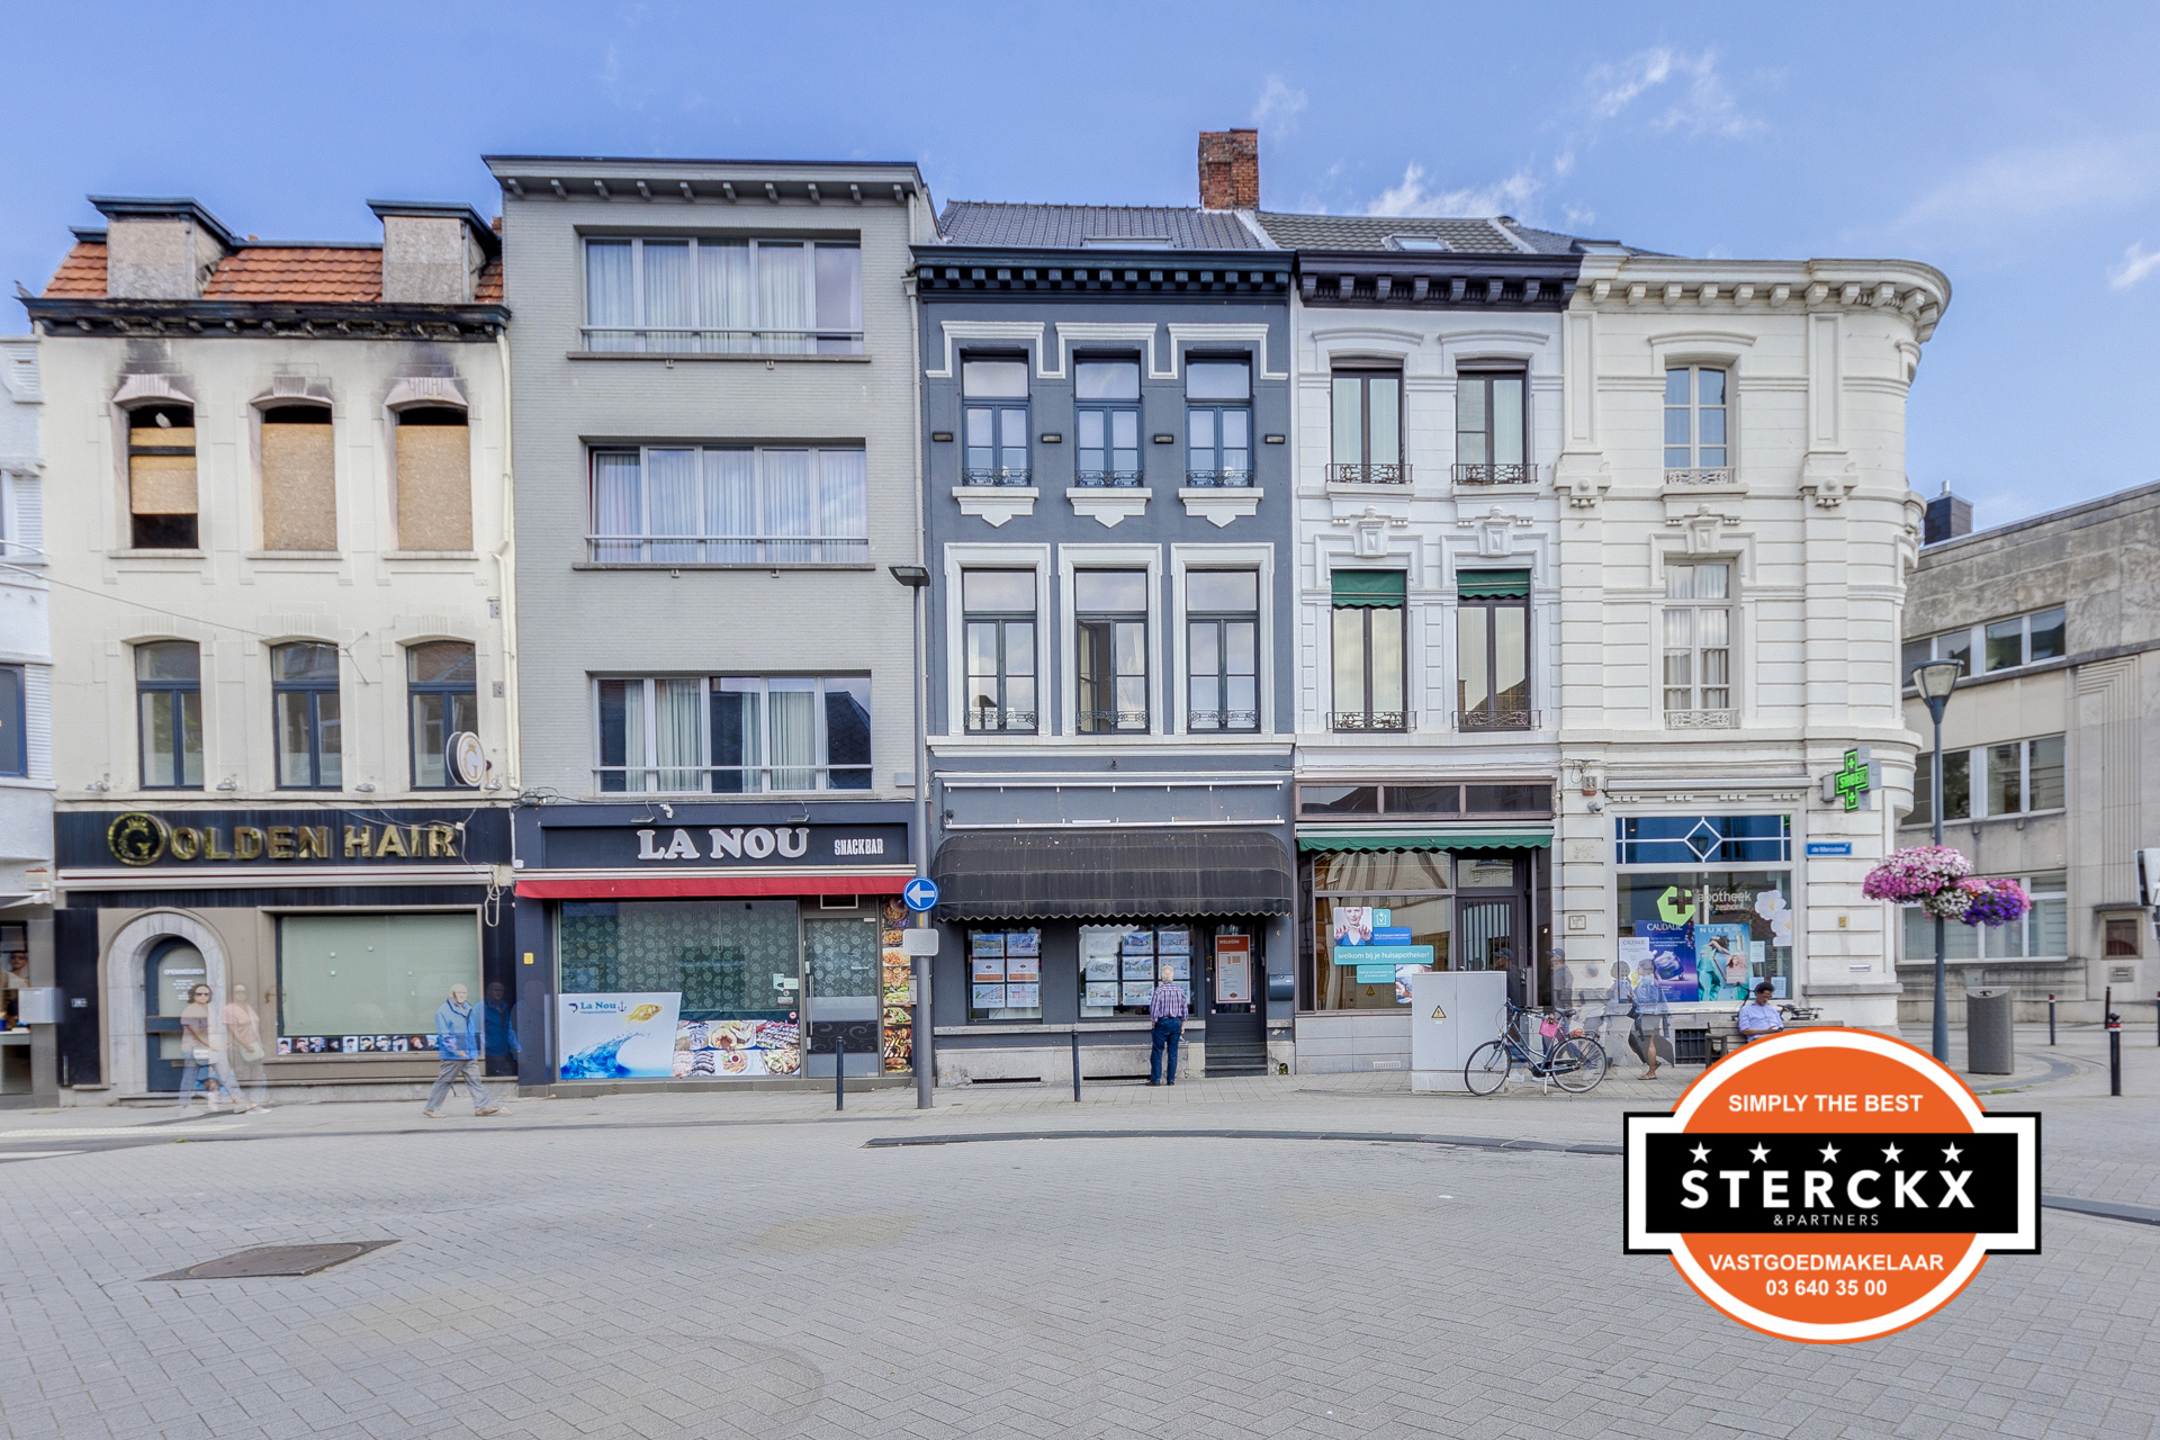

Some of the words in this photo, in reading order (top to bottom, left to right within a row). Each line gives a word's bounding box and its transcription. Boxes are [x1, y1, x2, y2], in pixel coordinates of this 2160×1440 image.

[113, 824, 330, 861] GOLDEN
[344, 825, 457, 858] HAIR
[637, 828, 701, 860] LA
[708, 827, 810, 859] NOU
[834, 838, 884, 856] SNACKBAR
[1698, 890, 1752, 904] apotheek
[1365, 952, 1374, 960] bij
[1374, 953, 1381, 961] je
[580, 1002, 593, 1010] La
[595, 1002, 617, 1010] Nou
